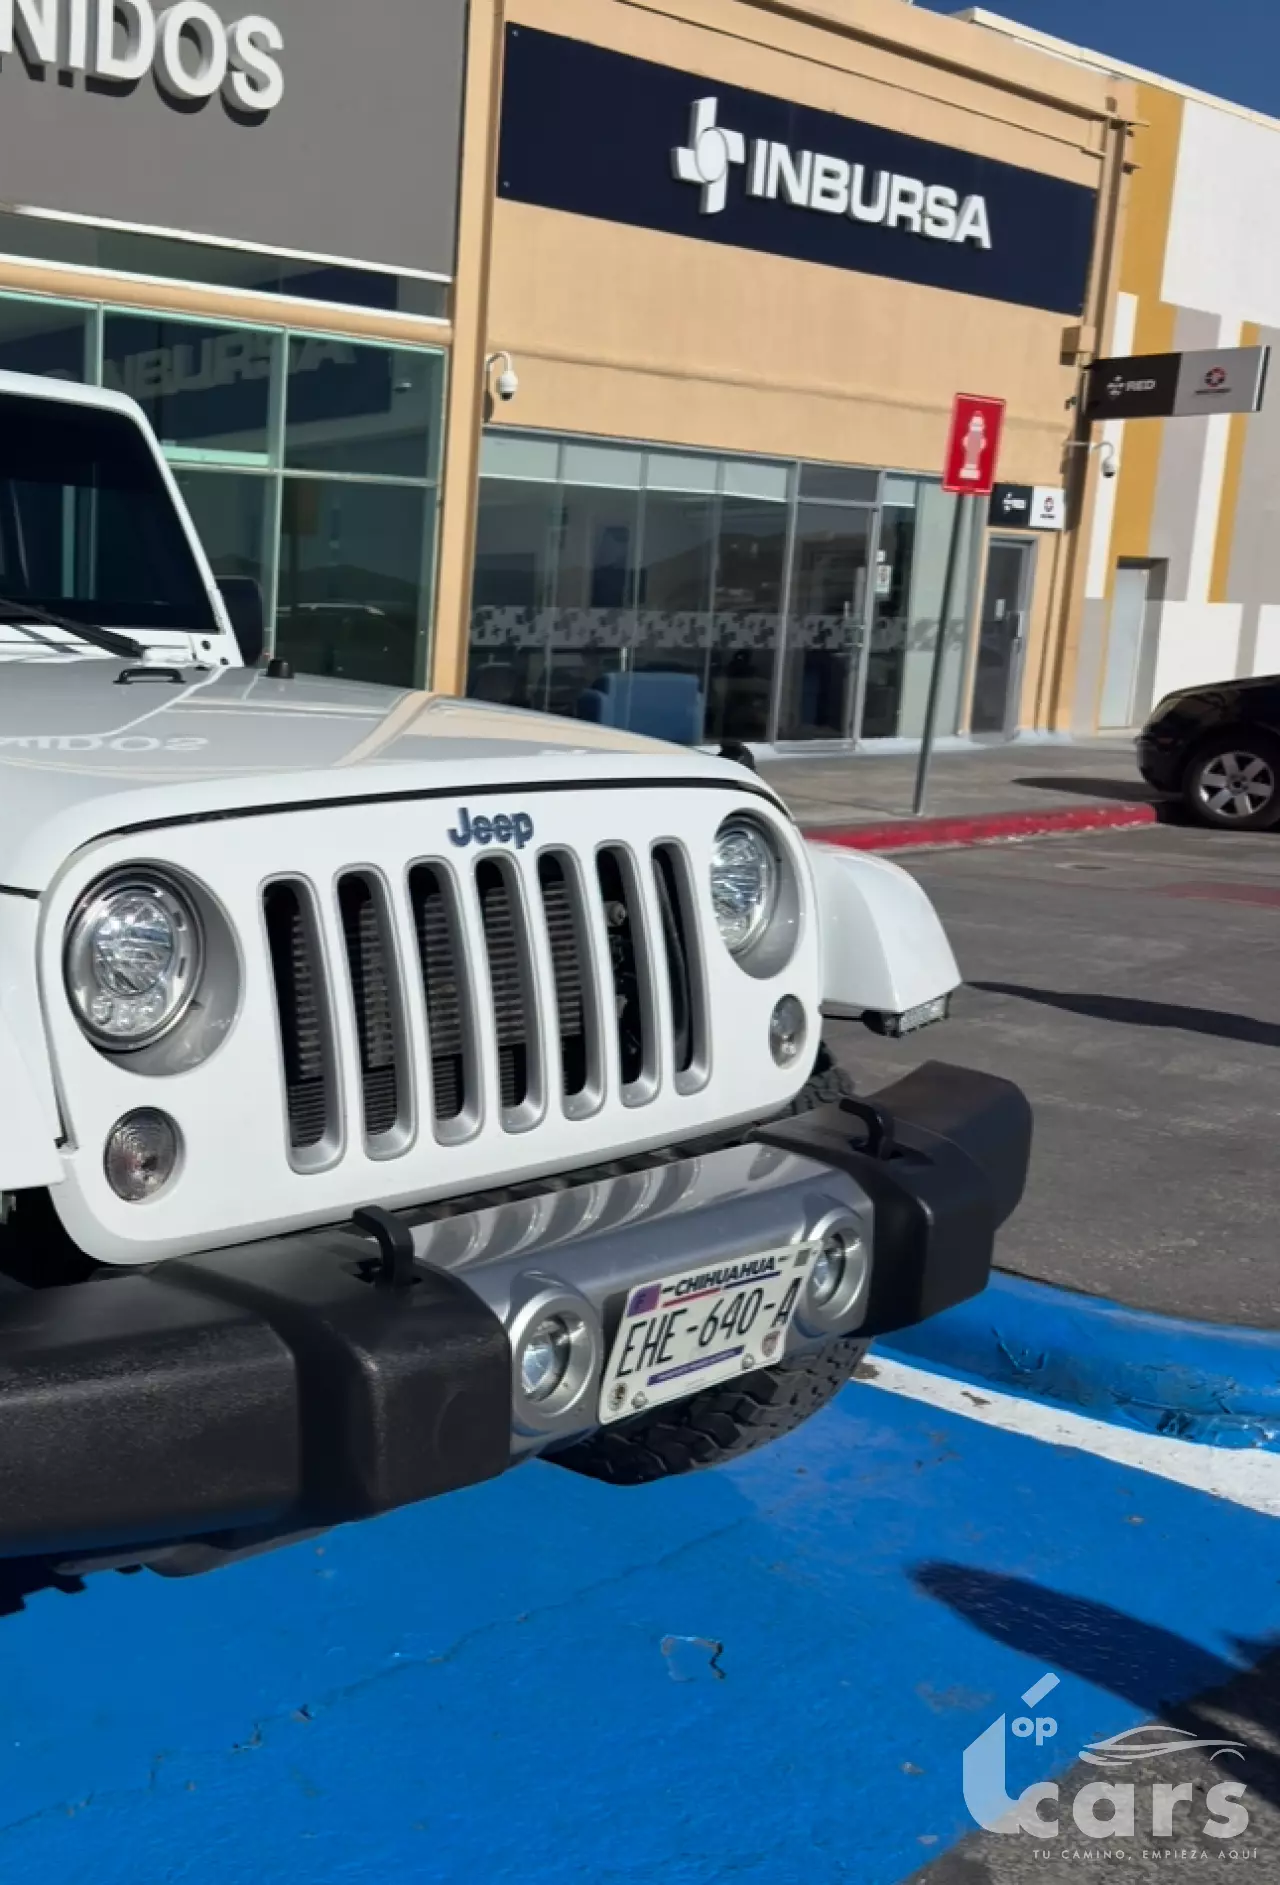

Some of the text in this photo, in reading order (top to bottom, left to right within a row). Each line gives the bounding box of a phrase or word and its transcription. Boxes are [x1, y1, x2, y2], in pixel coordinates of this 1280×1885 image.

[747, 138, 993, 249] INBURSA
[447, 807, 534, 850] Jeep
[674, 1256, 776, 1296] CHIHUAHUA
[616, 1276, 804, 1378] EHE-640-A
